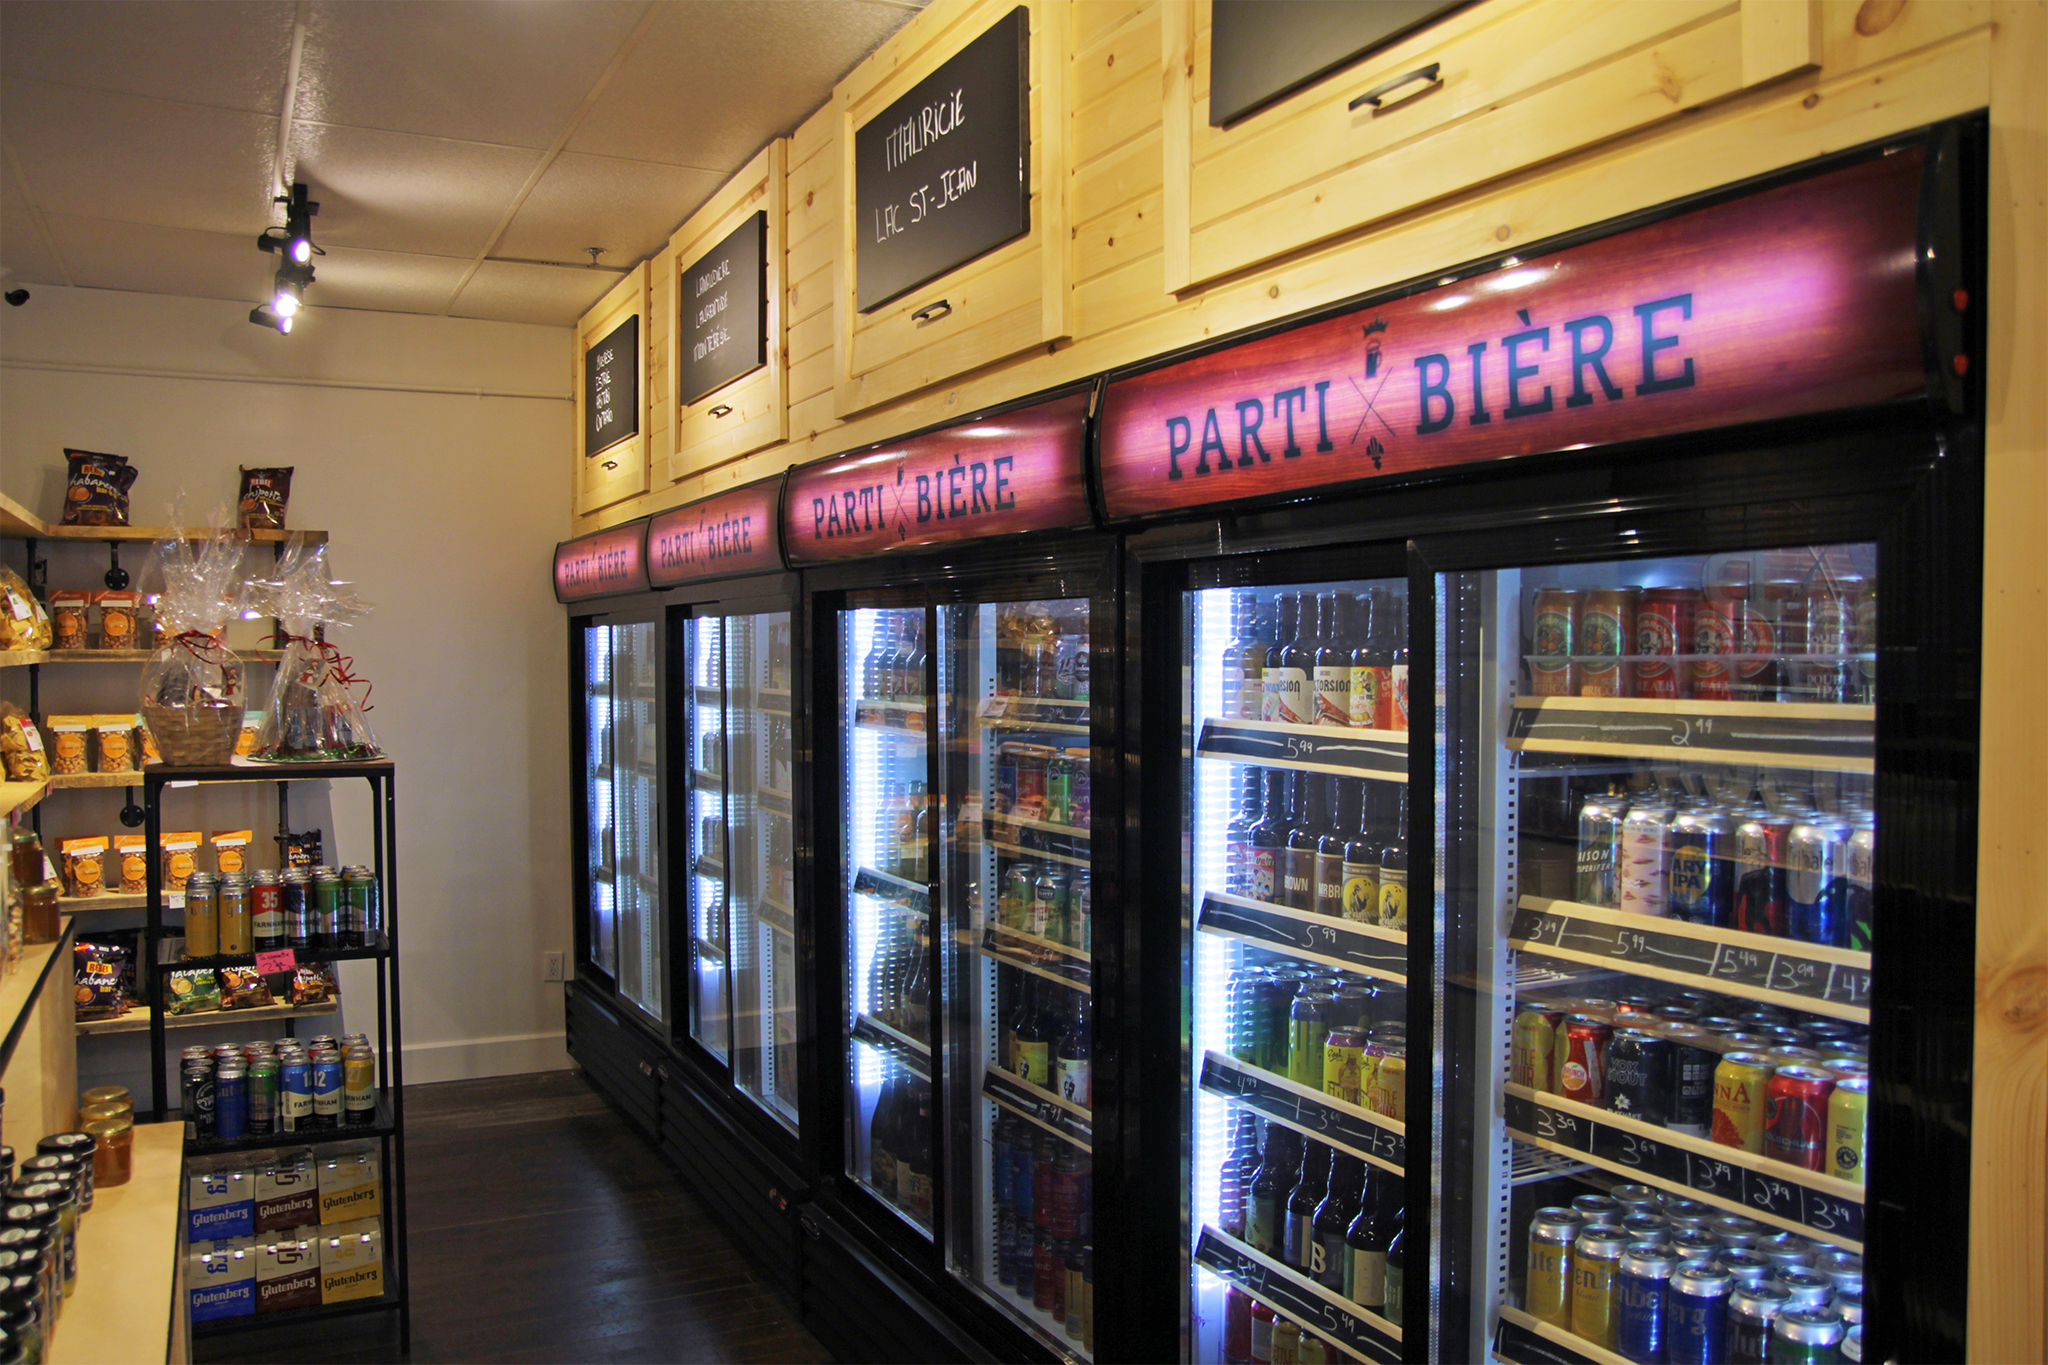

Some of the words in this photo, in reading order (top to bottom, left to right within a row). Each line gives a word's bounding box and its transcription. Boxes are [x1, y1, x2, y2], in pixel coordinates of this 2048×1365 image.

[886, 88, 966, 172] MAURICIE
[875, 204, 904, 243] LAC
[909, 160, 978, 223] ST-JEAN
[1166, 380, 1334, 480] PARTI
[1414, 293, 1696, 436] BIÈRE
[813, 484, 886, 539] PARTI
[916, 454, 1016, 524] BIÈRE
[660, 531, 696, 569] PARTI
[708, 513, 752, 560] BIÈRE
[564, 560, 589, 588] PARTI
[598, 547, 628, 582] BIÈRE
[1671, 718, 1713, 746] 299
[1282, 737, 1313, 759] 599
[261, 891, 279, 909] 35
[1301, 925, 1336, 948] 599
[1611, 931, 1645, 954] 599
[1719, 949, 1757, 973] 549
[1775, 962, 1814, 989] 399
[1563, 1066, 1585, 1079] BRUNCH
[1536, 1108, 1576, 1137] 339
[1619, 1135, 1656, 1164] 369
[1699, 1160, 1731, 1189] 379
[1754, 1179, 1789, 1210] 279
[260, 1197, 313, 1219] Glutenberg
[323, 1187, 375, 1211] Glutenberg
[192, 1207, 248, 1228] Glutenberg
[261, 1276, 316, 1299] Glutenberg
[324, 1269, 377, 1291] Glutenberg
[193, 1286, 249, 1307] Glutenberg
